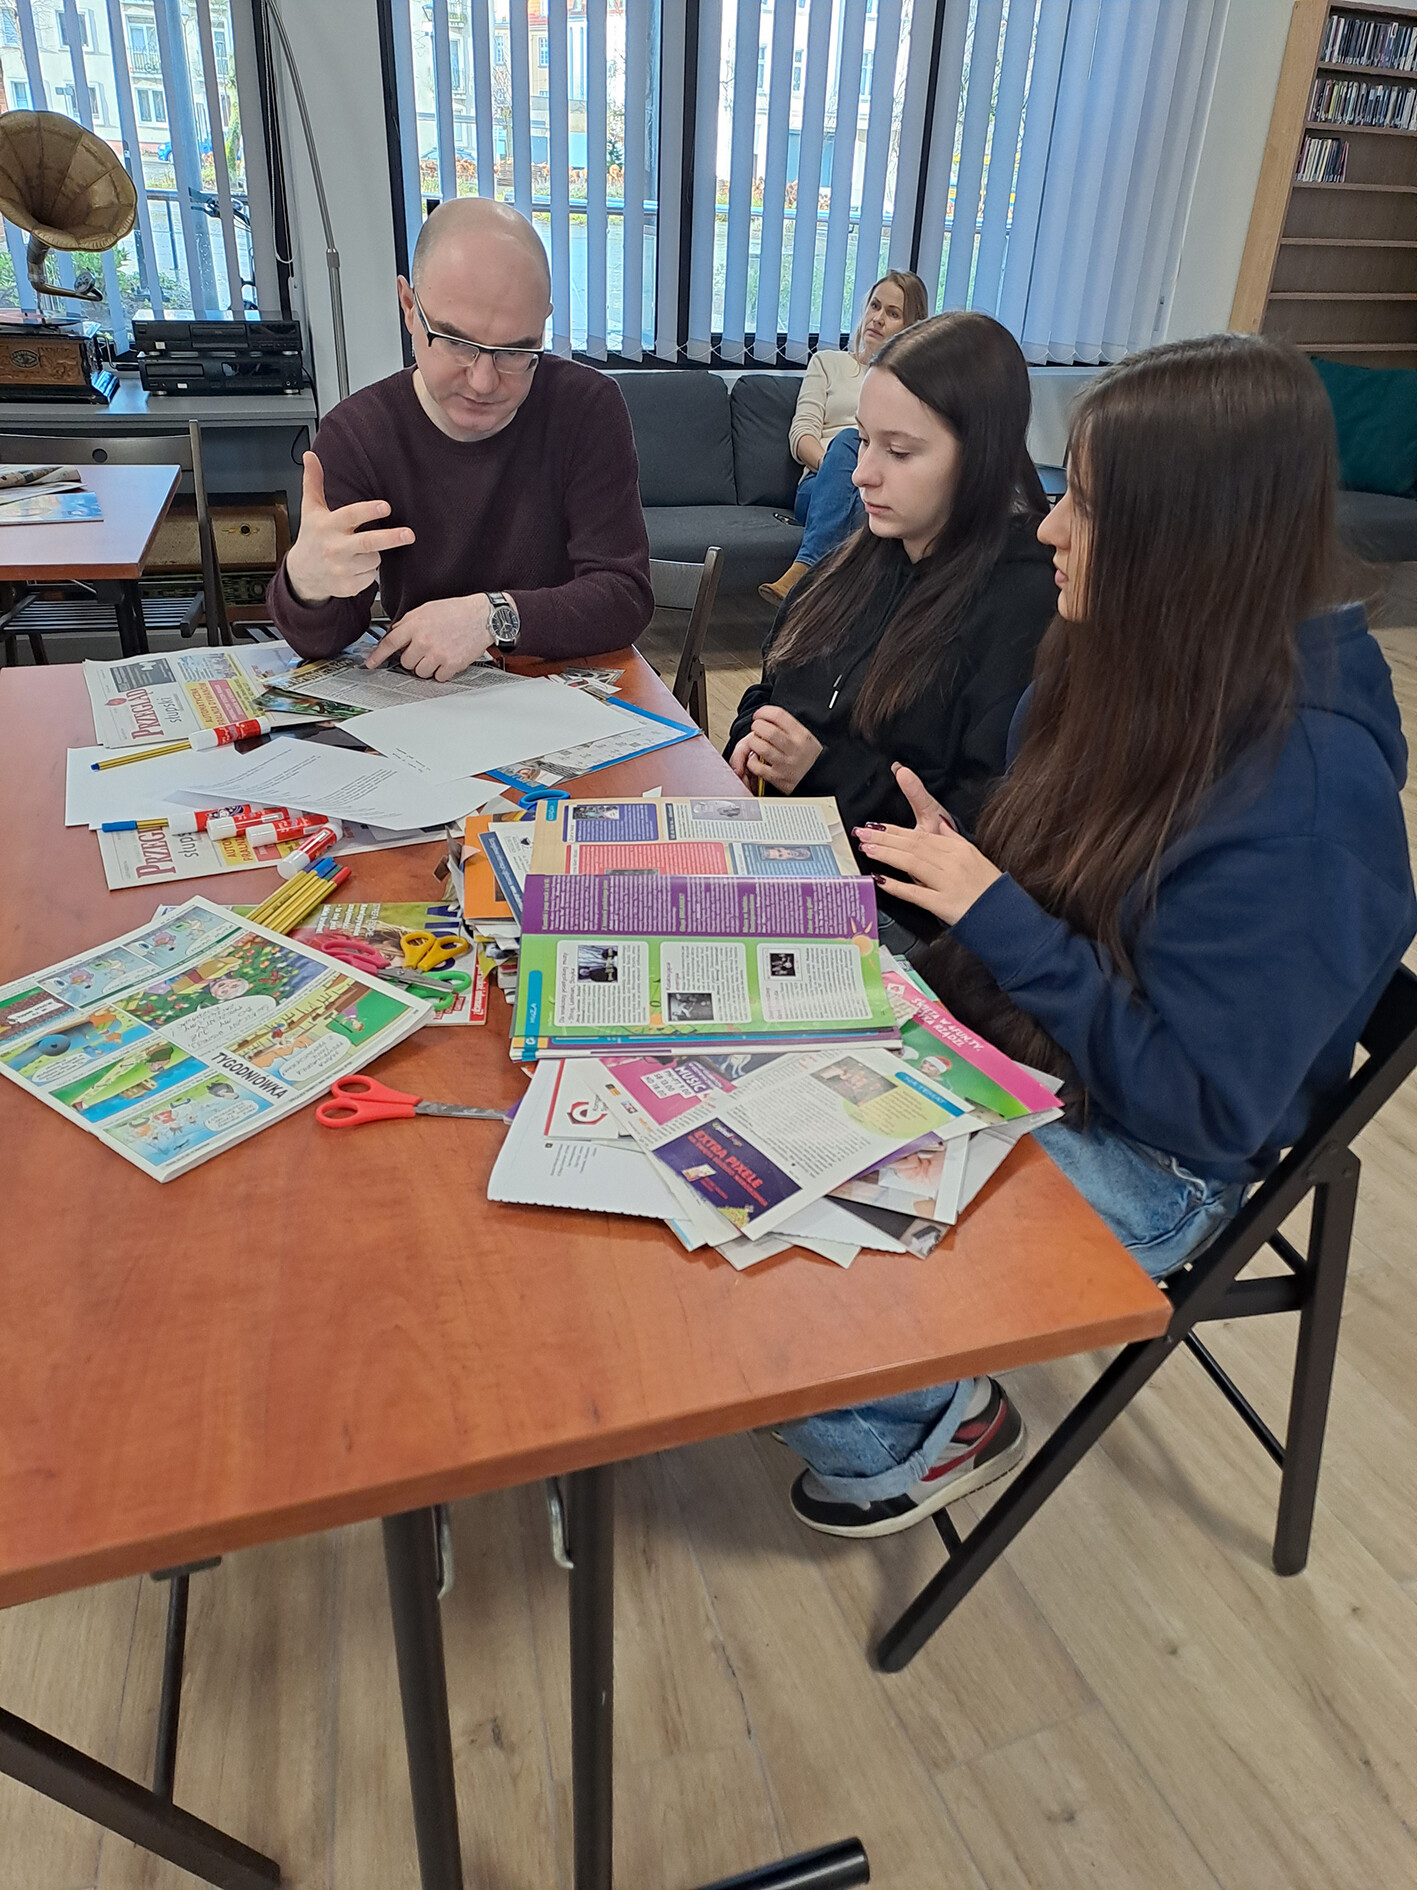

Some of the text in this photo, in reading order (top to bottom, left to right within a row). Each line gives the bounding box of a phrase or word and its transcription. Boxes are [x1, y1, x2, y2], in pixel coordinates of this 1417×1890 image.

[126, 688, 164, 740] PRZEGLĄD
[158, 696, 182, 723] słupski
[190, 688, 213, 723] AUTOMATYCZNA
[135, 827, 176, 878] PRZEGL
[911, 996, 940, 1020] ŚWIĘTA
[212, 1052, 290, 1099] TYGODNIÓWKA
[674, 1065, 706, 1092] MUSIC
[694, 1129, 728, 1158] EXTRA
[725, 1155, 764, 1189] PIXELE
